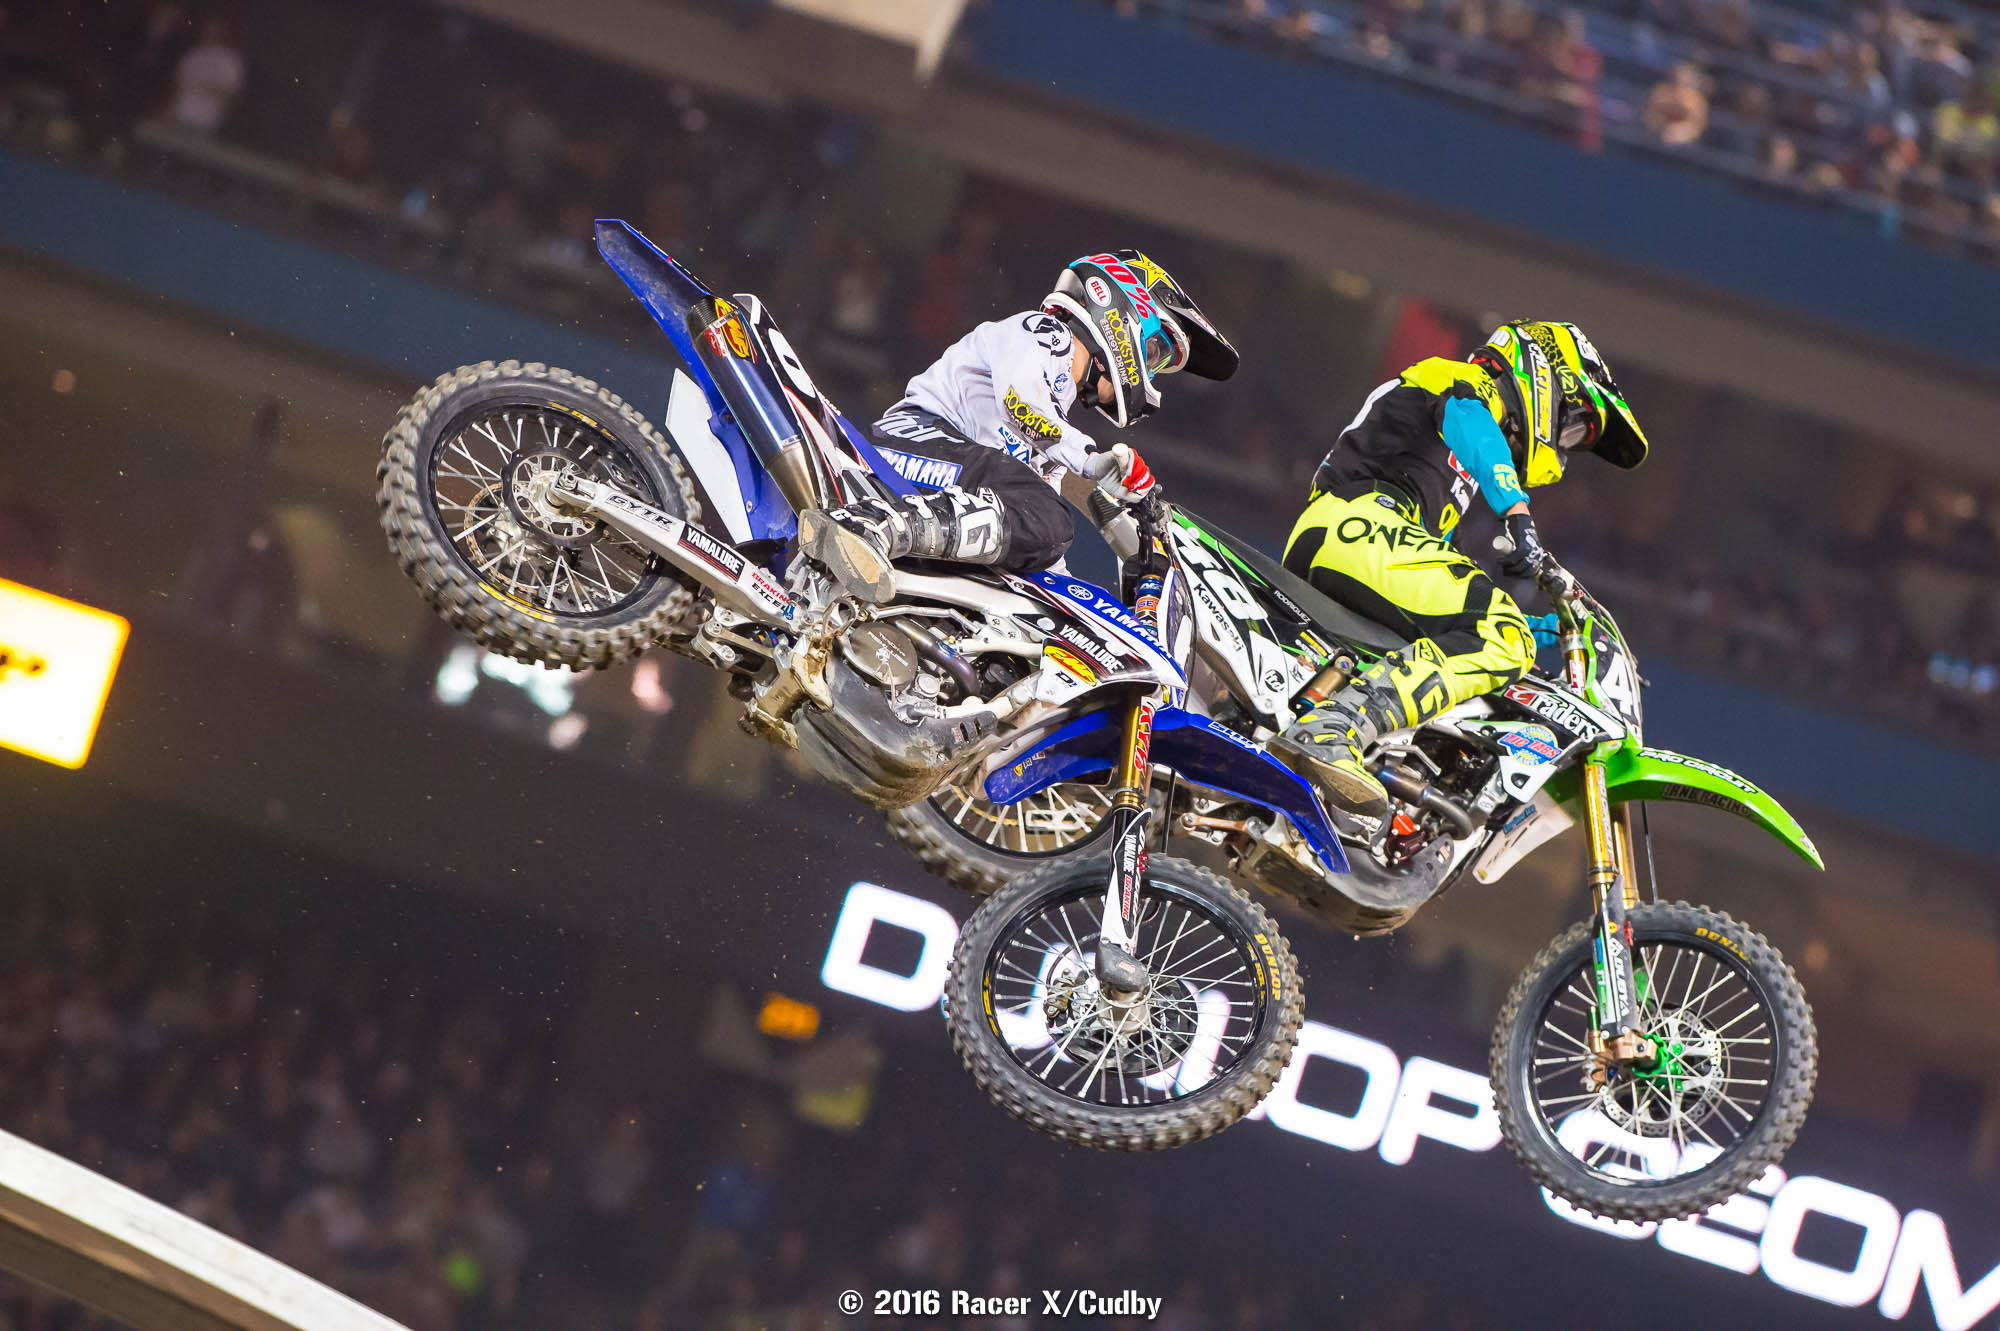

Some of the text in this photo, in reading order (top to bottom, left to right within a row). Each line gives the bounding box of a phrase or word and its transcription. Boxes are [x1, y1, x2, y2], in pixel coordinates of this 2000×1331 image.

[1090, 280, 1107, 302] BELL
[1101, 318, 1130, 386] ENERGY DRINK
[610, 495, 674, 527] GYTR
[686, 526, 744, 574] YAMALUBE
[1167, 521, 1268, 620] 48
[1193, 583, 1244, 652] Kawasaki
[1274, 590, 1312, 624] RODRIGUEZ
[1058, 624, 1124, 674] YAMALUBE
[1503, 733, 1528, 748] TIC
[1528, 739, 1561, 758] TABS
[1639, 750, 1683, 764] PRO
[1683, 760, 1758, 794] CIRCUIT
[1123, 834, 1137, 876] YAMALUBE
[1122, 874, 1133, 921] BRAKING
[1254, 932, 1281, 1000] DUNLOP
